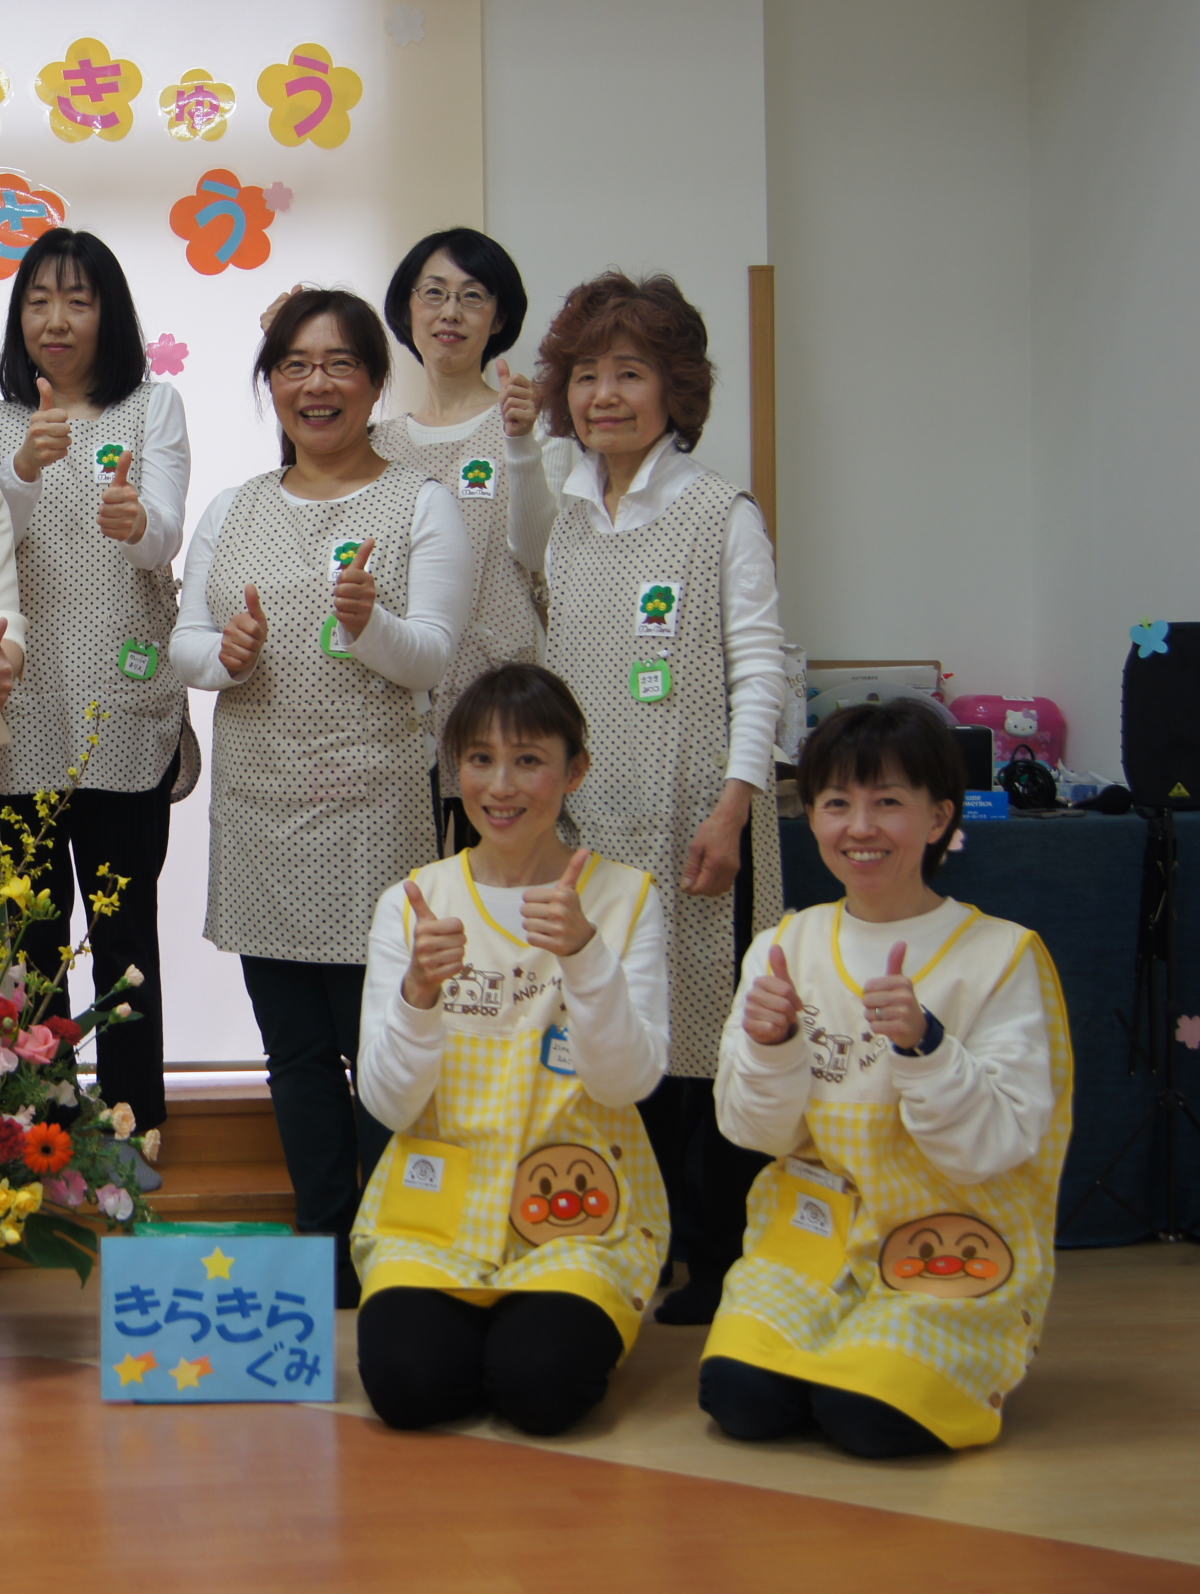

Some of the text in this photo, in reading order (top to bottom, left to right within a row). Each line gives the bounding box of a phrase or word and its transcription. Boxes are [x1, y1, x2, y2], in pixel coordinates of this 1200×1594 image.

[114, 1285, 315, 1343] きらきら
[245, 1341, 321, 1388] ぐみ
